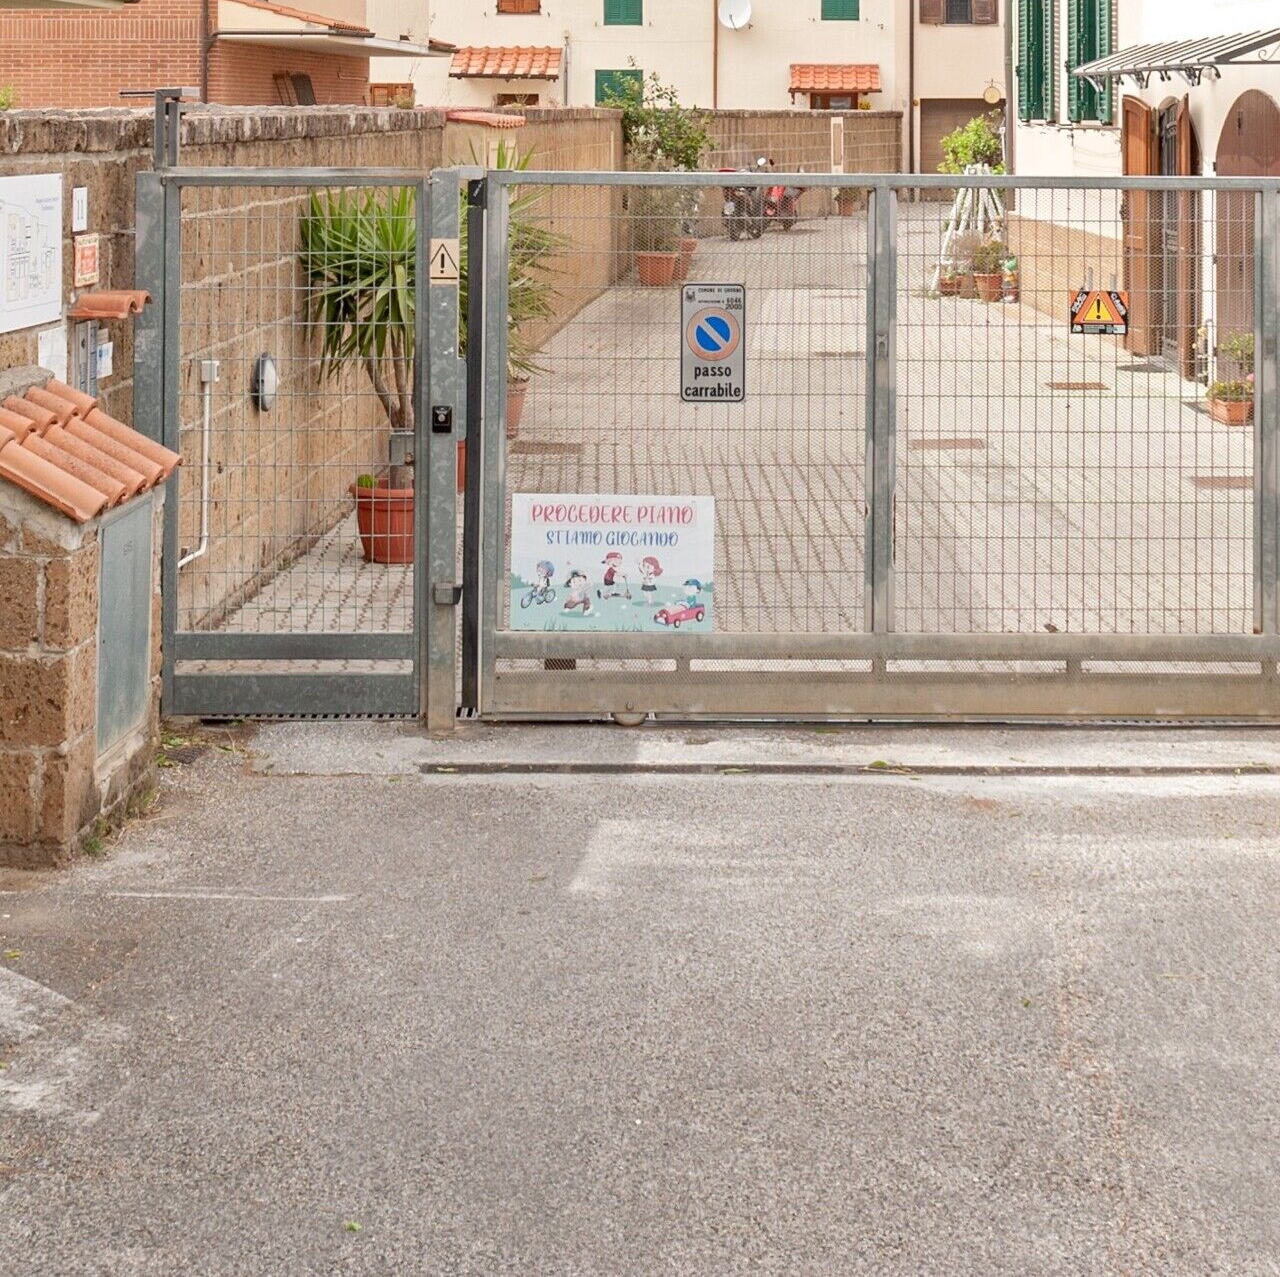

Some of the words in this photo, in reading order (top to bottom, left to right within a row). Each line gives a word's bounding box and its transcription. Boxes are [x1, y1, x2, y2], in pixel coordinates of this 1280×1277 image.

[694, 366, 732, 380] passo
[684, 382, 741, 397] carrabile
[531, 503, 633, 523] PROCEDERE
[637, 505, 694, 524] PIANO
[546, 529, 602, 547] STIAMO
[606, 530, 679, 547] GIOCANDO
